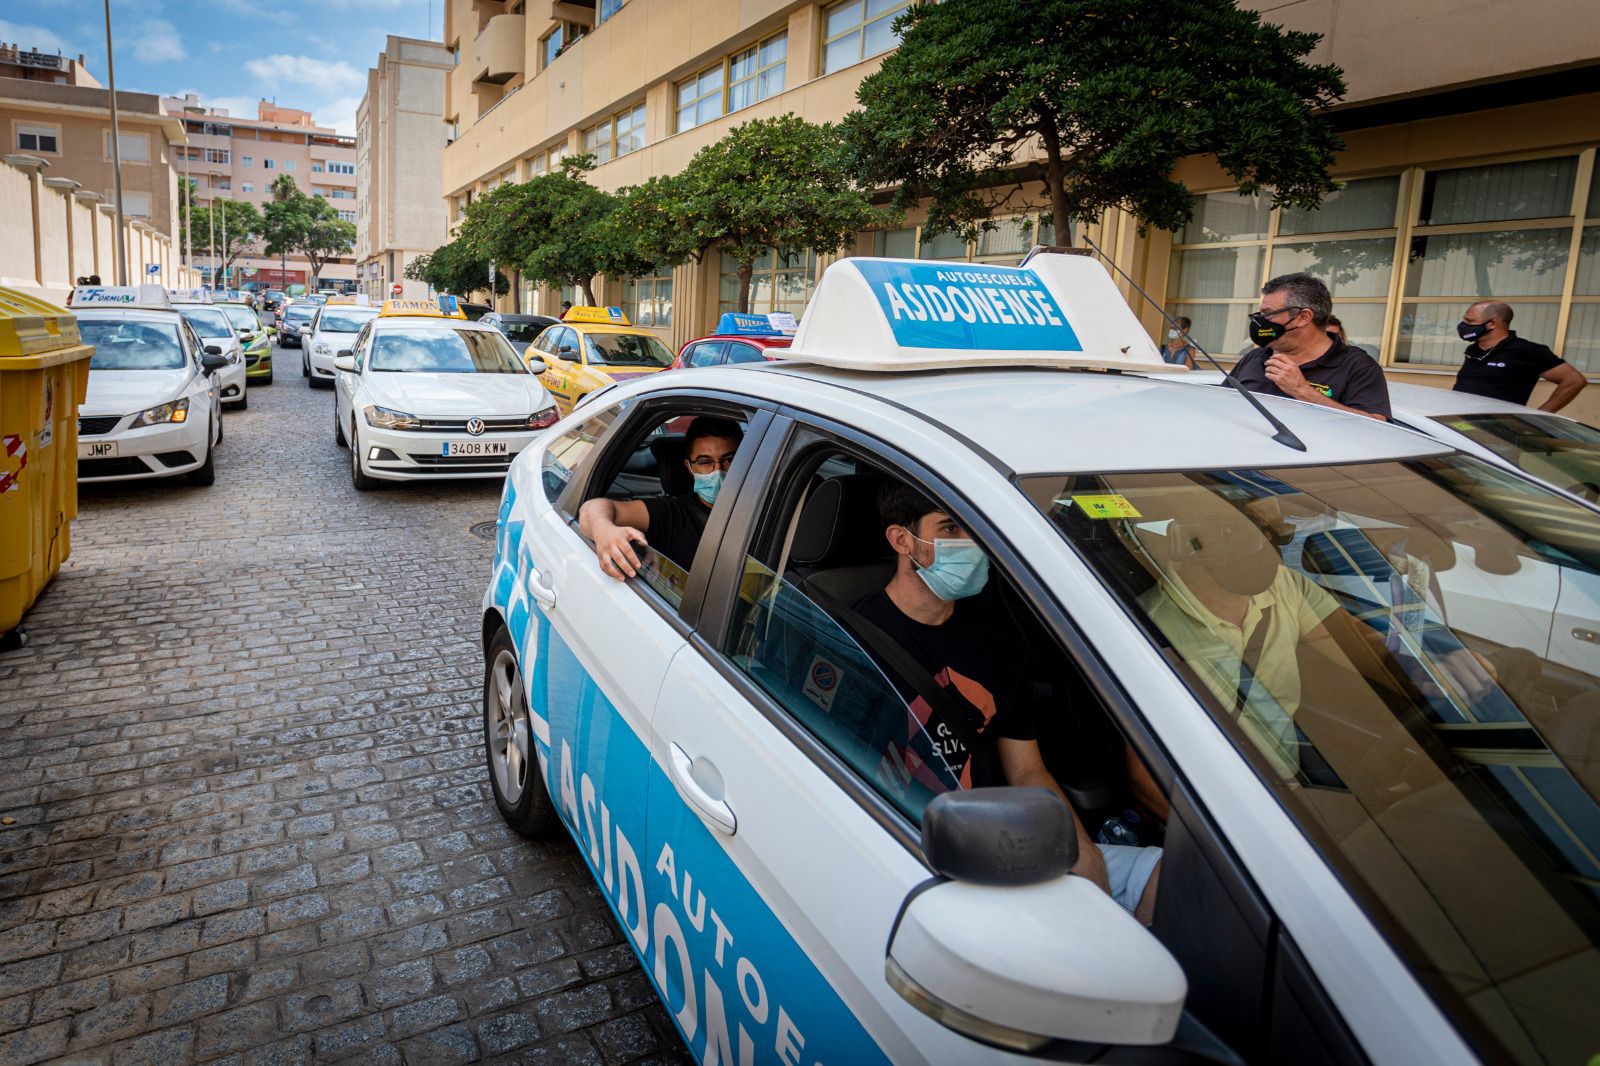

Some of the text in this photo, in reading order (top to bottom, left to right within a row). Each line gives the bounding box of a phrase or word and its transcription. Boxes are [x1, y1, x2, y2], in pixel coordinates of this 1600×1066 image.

[937, 271, 1037, 286] AUTOESCUELA
[884, 282, 1063, 326] ASIDONENSE
[87, 443, 112, 456] JMP
[451, 443, 507, 455] 3408 KWM
[656, 842, 824, 1066] AUTOE
